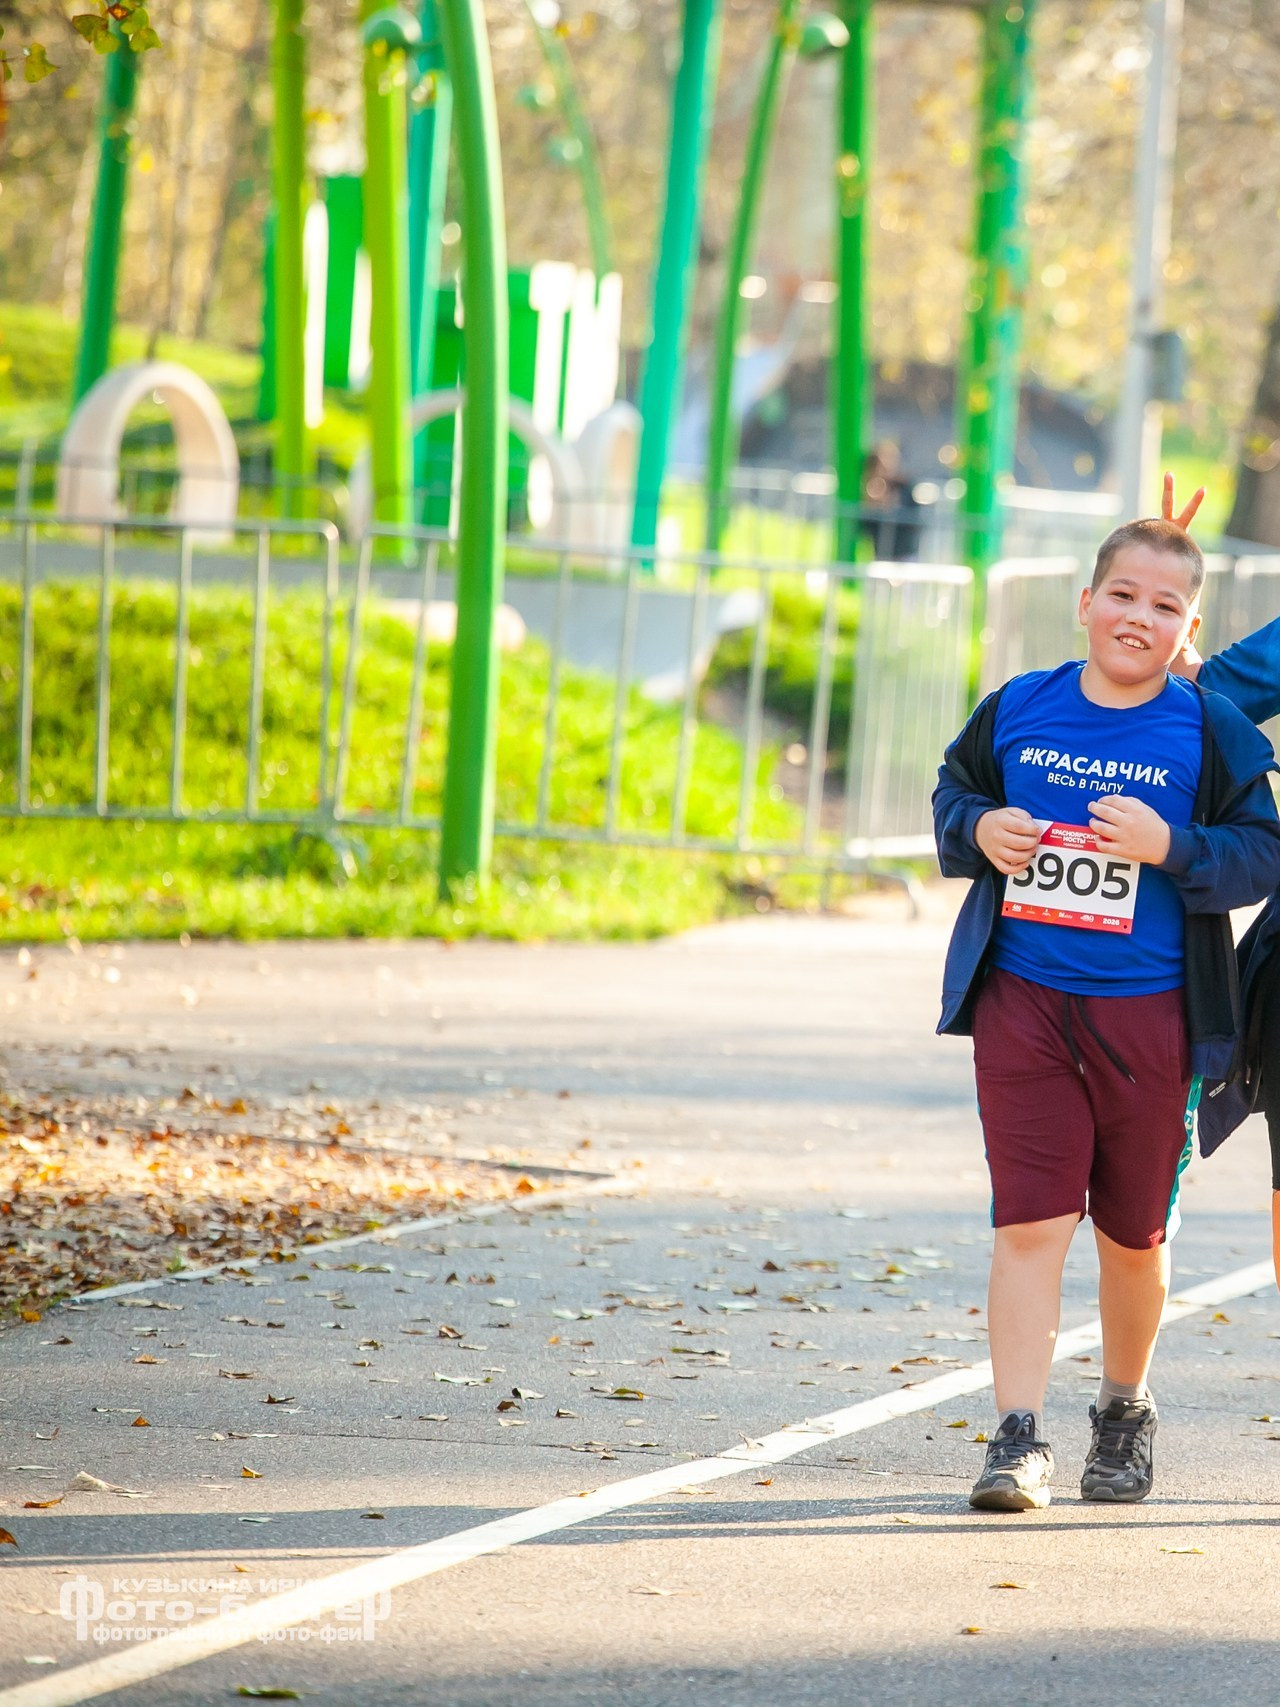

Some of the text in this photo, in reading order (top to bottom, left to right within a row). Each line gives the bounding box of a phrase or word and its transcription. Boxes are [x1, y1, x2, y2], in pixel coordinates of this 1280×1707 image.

[1019, 746, 1170, 787] #КРАСАВЧИК
[1047, 772, 1124, 794] ВЕСЬ В ПАПУ
[1051, 828, 1098, 841] КРАСНОЯРСКИ
[1062, 835, 1086, 844] МОСТЫ
